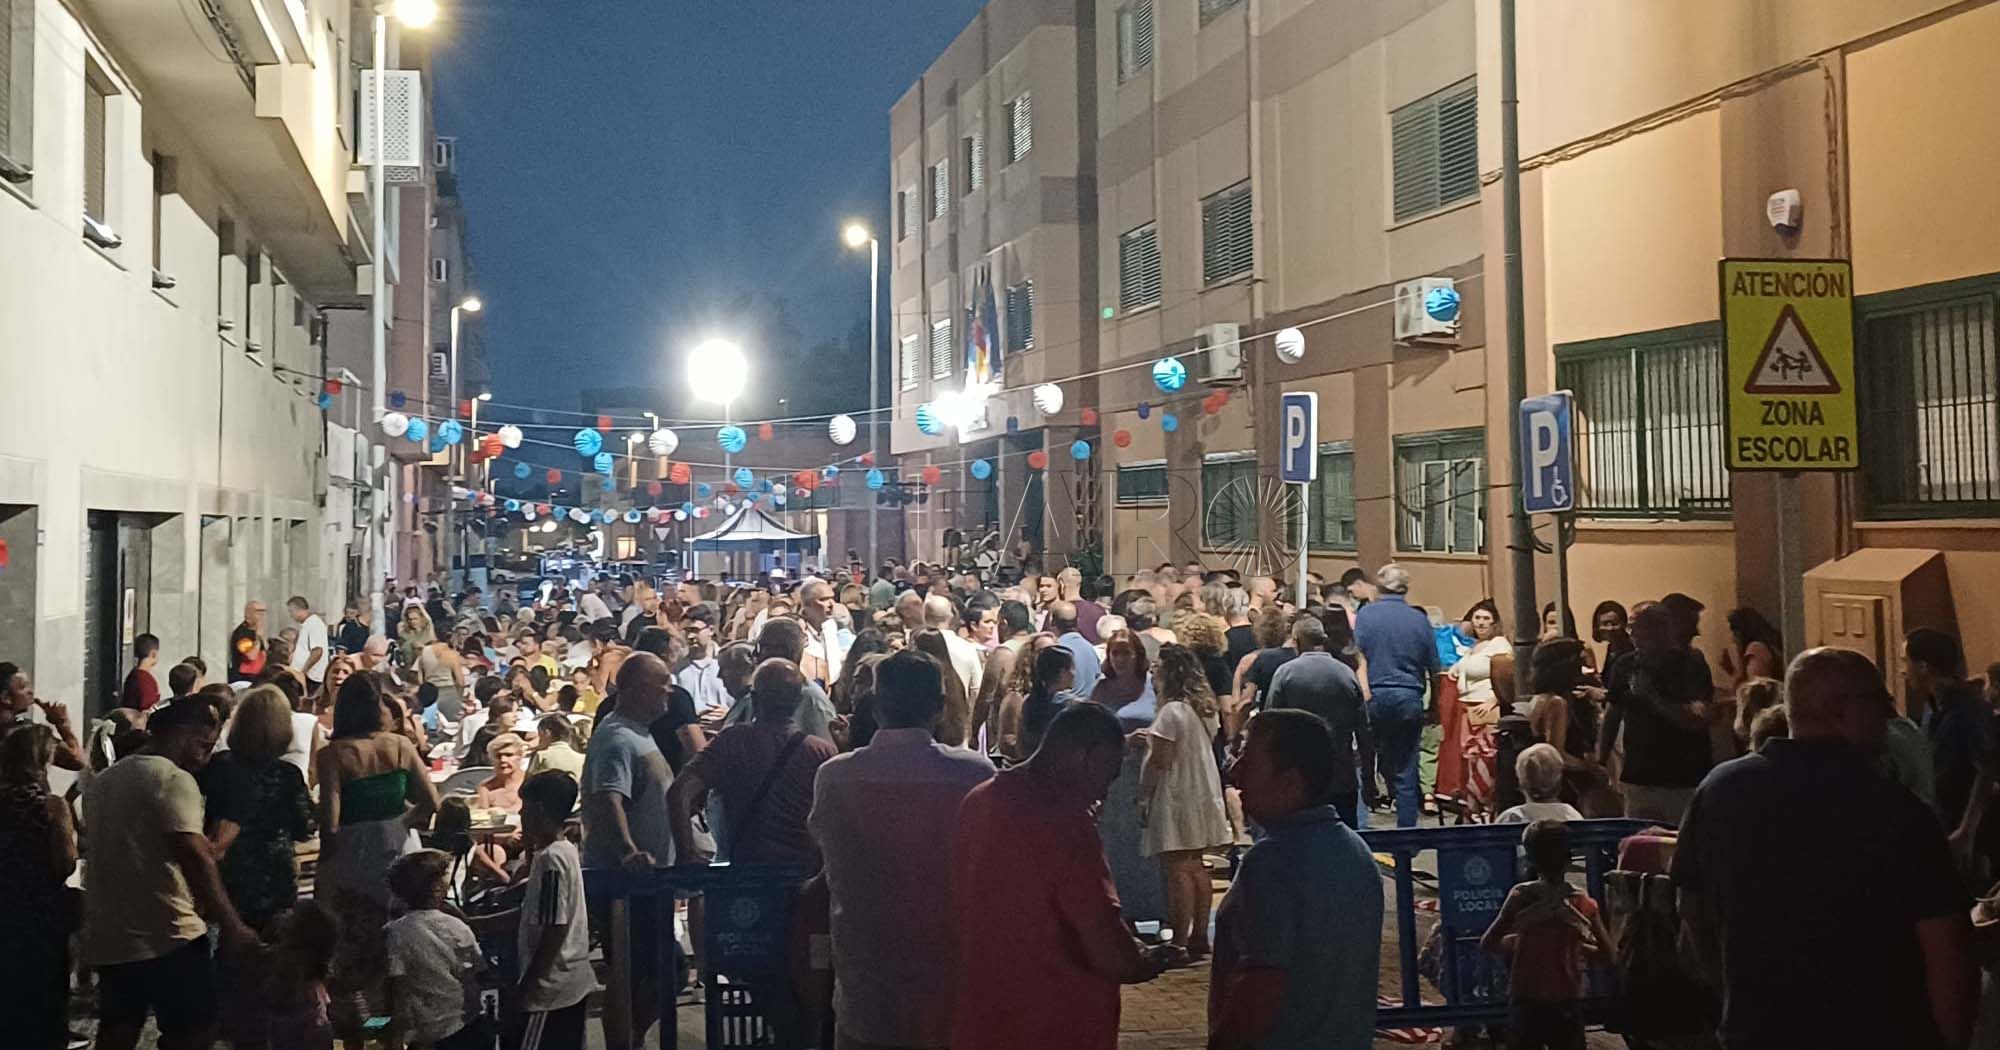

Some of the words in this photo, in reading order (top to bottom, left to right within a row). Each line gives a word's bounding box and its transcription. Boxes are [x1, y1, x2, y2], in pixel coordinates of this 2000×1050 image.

[1732, 266, 1845, 298] ATENCIÓN
[1761, 400, 1825, 426] ZONA
[1286, 404, 1306, 472] P
[1737, 436, 1850, 462] ESCOLAR
[1529, 410, 1560, 499] P
[1458, 899, 1500, 912] LOCAL
